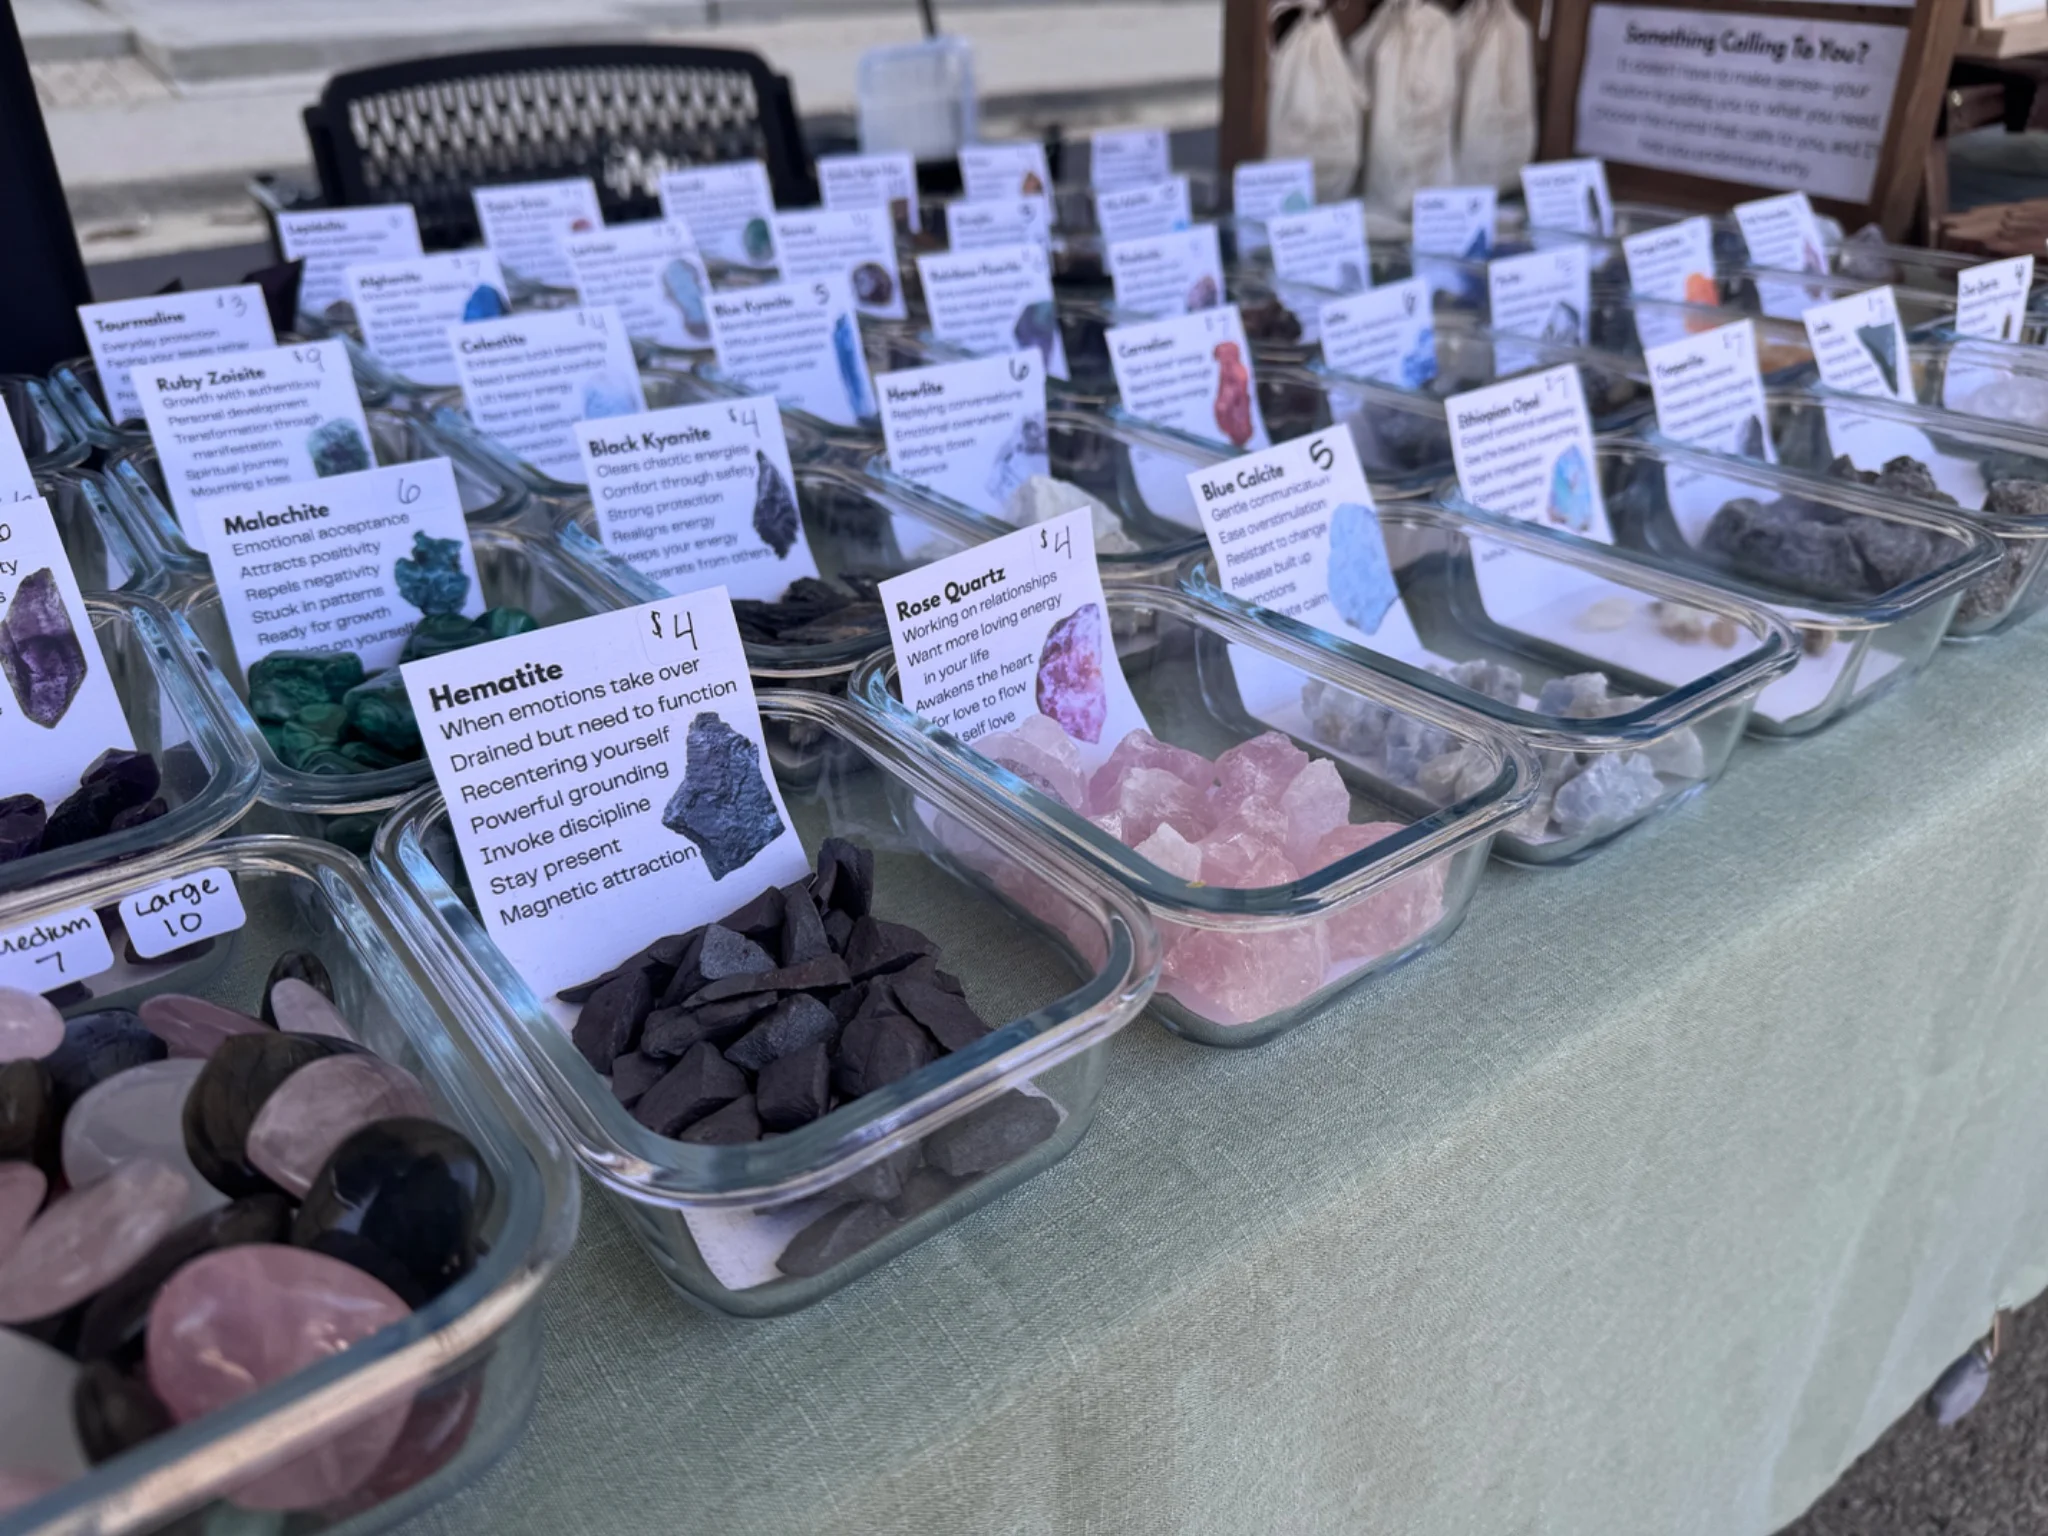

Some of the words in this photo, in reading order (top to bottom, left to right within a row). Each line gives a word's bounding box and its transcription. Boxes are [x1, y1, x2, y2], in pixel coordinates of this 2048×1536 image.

[1625, 22, 1716, 56] Something
[1720, 29, 1787, 62] Calling
[1791, 35, 1814, 60] To
[1819, 39, 1870, 65] You?
[94, 311, 185, 333] Tourmaline
[156, 375, 202, 393] Ruby
[207, 365, 266, 385] Zoisite
[1008, 358, 1030, 382] 6
[162, 394, 213, 410] Growth
[216, 387, 245, 402] with
[168, 410, 225, 426] Personal
[228, 399, 309, 420] development
[173, 421, 272, 444] Transformation
[728, 408, 760, 438] $4
[192, 438, 282, 461] manifestation
[588, 434, 639, 458] Black
[641, 426, 711, 453] Kyanite
[1309, 439, 1334, 471] 5
[185, 463, 241, 481] Spiritual
[242, 456, 289, 474] journey
[596, 460, 640, 478] Clears
[643, 453, 692, 472] chaotic
[694, 444, 750, 464] energies
[190, 480, 254, 499] Mourning
[267, 474, 290, 486] loss
[398, 478, 421, 504] 6
[602, 480, 657, 500] Comfort
[661, 470, 714, 492] through
[716, 464, 756, 481] safety
[1201, 480, 1235, 500] Blue
[1237, 465, 1284, 490] Calcite
[1211, 500, 1248, 523] Gentle
[1250, 476, 1331, 508] communication
[224, 502, 330, 536] Malachite
[607, 502, 654, 522] Strong
[657, 492, 724, 515] protection
[1218, 527, 1246, 545] Ease
[1247, 500, 1327, 535] overstimulation
[232, 529, 315, 557] Emotional
[318, 511, 410, 541] acceptance
[612, 523, 669, 544] Realigns
[672, 515, 715, 535] energy
[664, 540, 691, 558] your
[695, 532, 738, 551] energy
[1040, 526, 1072, 560] $4
[1226, 541, 1275, 567] Resistant
[1276, 537, 1287, 549] to
[1289, 521, 1326, 545] change
[241, 557, 308, 580] Attracts
[311, 540, 382, 567] positivity
[697, 554, 730, 571] from
[732, 545, 772, 564] others
[1231, 567, 1273, 590] Release
[1275, 555, 1296, 573] built
[1298, 551, 1311, 566] up
[245, 579, 301, 602] Repels
[303, 563, 380, 590] negativity
[896, 591, 941, 622] Rose
[944, 567, 1006, 604] Quartz
[1249, 580, 1297, 605] motions
[252, 602, 299, 624] Stuck
[302, 598, 317, 612] in
[320, 584, 384, 611] patterns
[902, 611, 959, 645] Working
[961, 604, 978, 620] on
[980, 570, 1058, 613] relationships
[1303, 592, 1329, 612] calm
[258, 622, 307, 646] Ready
[310, 619, 332, 635] for
[336, 606, 392, 632] growth
[336, 637, 352, 651] on
[356, 621, 415, 649] yourself
[650, 611, 699, 652] $4
[907, 644, 944, 668] Want
[945, 629, 979, 650] more
[981, 612, 1019, 640] loving
[1020, 594, 1062, 621] energy
[916, 676, 975, 713] Awakens
[977, 667, 999, 685] the
[1000, 652, 1034, 676] heart
[923, 672, 936, 685] in
[939, 657, 968, 683] your
[970, 648, 990, 666] life
[428, 660, 564, 712] Hematite
[440, 712, 504, 741] When
[509, 683, 606, 725] emotions
[609, 670, 655, 694] take
[659, 658, 700, 683] over
[931, 711, 950, 730] for
[953, 699, 980, 721] love
[983, 692, 996, 707] to
[999, 681, 1027, 703] flow
[450, 733, 533, 774] Drained
[538, 722, 573, 747] but
[578, 708, 630, 736] need
[633, 702, 655, 724] to
[658, 678, 737, 714] function
[963, 720, 986, 743] self
[988, 709, 1016, 732] love
[460, 752, 589, 804] Recentering
[591, 725, 671, 769] yourself
[470, 788, 565, 835] Powerful
[569, 760, 669, 807] grounding
[480, 830, 555, 866] Invoke
[559, 795, 652, 842] discipline
[490, 866, 539, 897] Stay
[545, 837, 623, 882] present
[135, 879, 219, 917] Large
[499, 880, 599, 927] Magnetic
[601, 843, 697, 890] attraction
[164, 912, 202, 937] 10
[35, 951, 64, 973] 7
